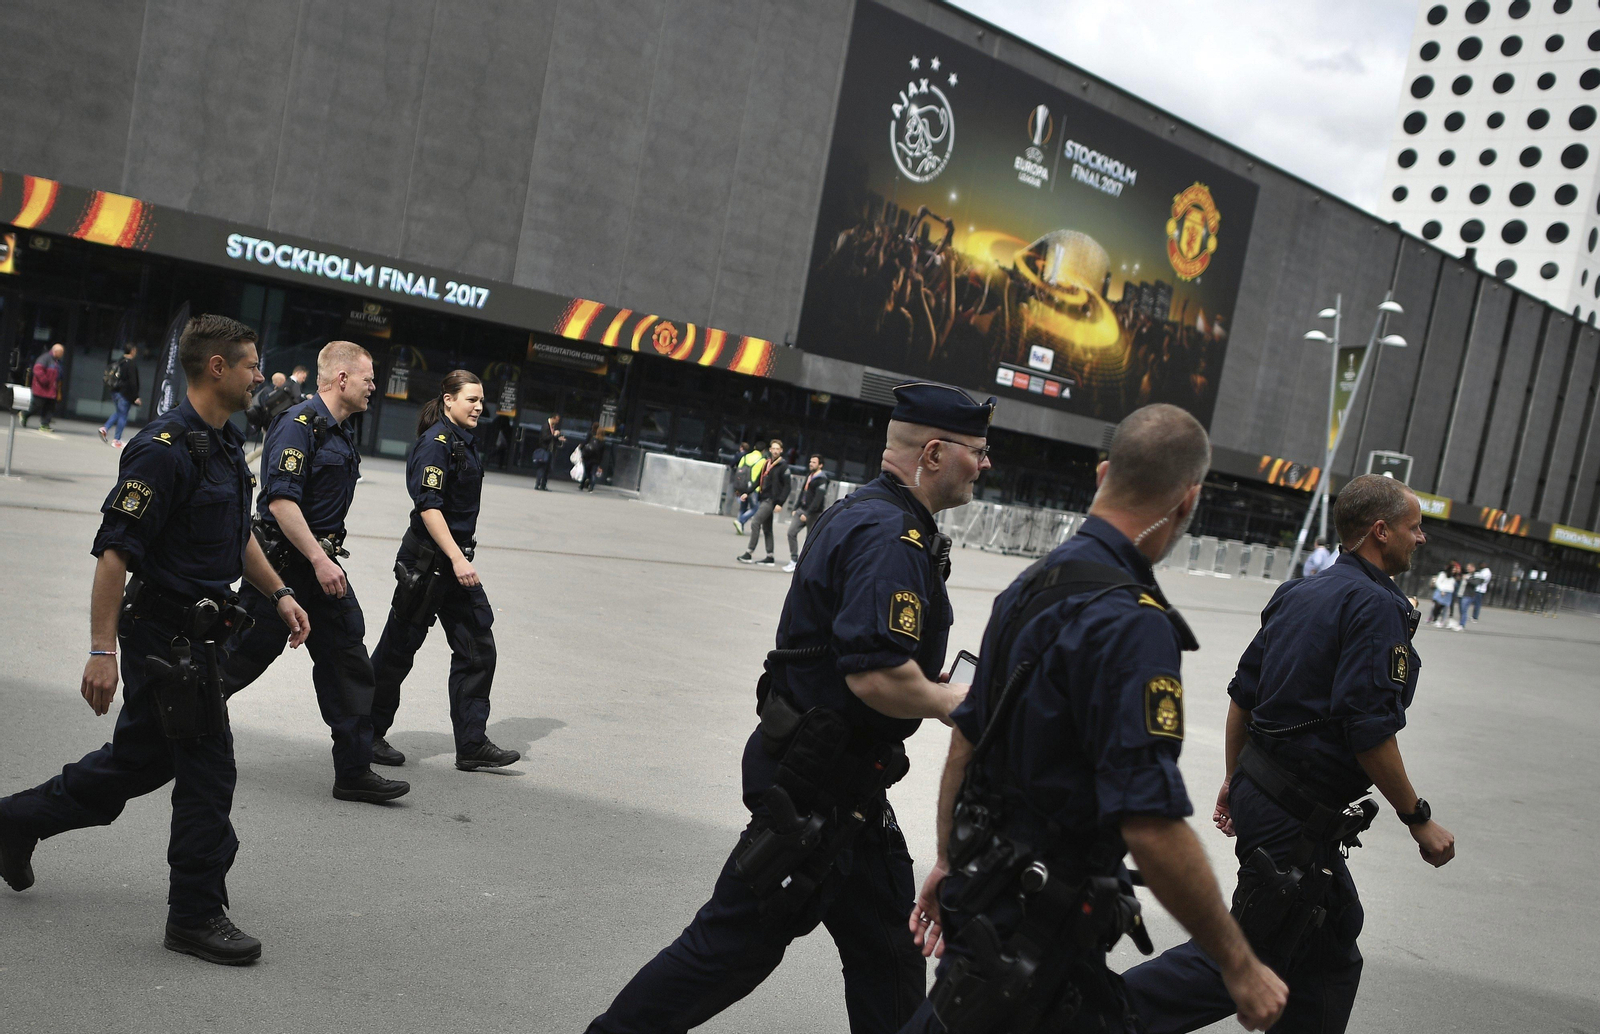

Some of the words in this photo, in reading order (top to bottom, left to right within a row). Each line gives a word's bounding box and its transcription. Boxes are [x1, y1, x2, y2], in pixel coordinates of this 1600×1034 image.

[891, 78, 930, 118] AJAX
[1064, 139, 1138, 187] STOCKHOLM
[1071, 162, 1101, 190] FINAL
[1099, 175, 1124, 198] 2017
[225, 233, 376, 287] STOCKHOLM
[377, 266, 440, 299] FINAL
[443, 280, 490, 309] 2017
[350, 310, 367, 321] EXIT
[367, 313, 387, 324] ONLY
[532, 343, 581, 358] ACCREDITATION
[580, 352, 605, 363] CENTRE
[284, 450, 302, 460] POLIS
[425, 466, 443, 476] POLIS
[126, 482, 151, 497] POLIS
